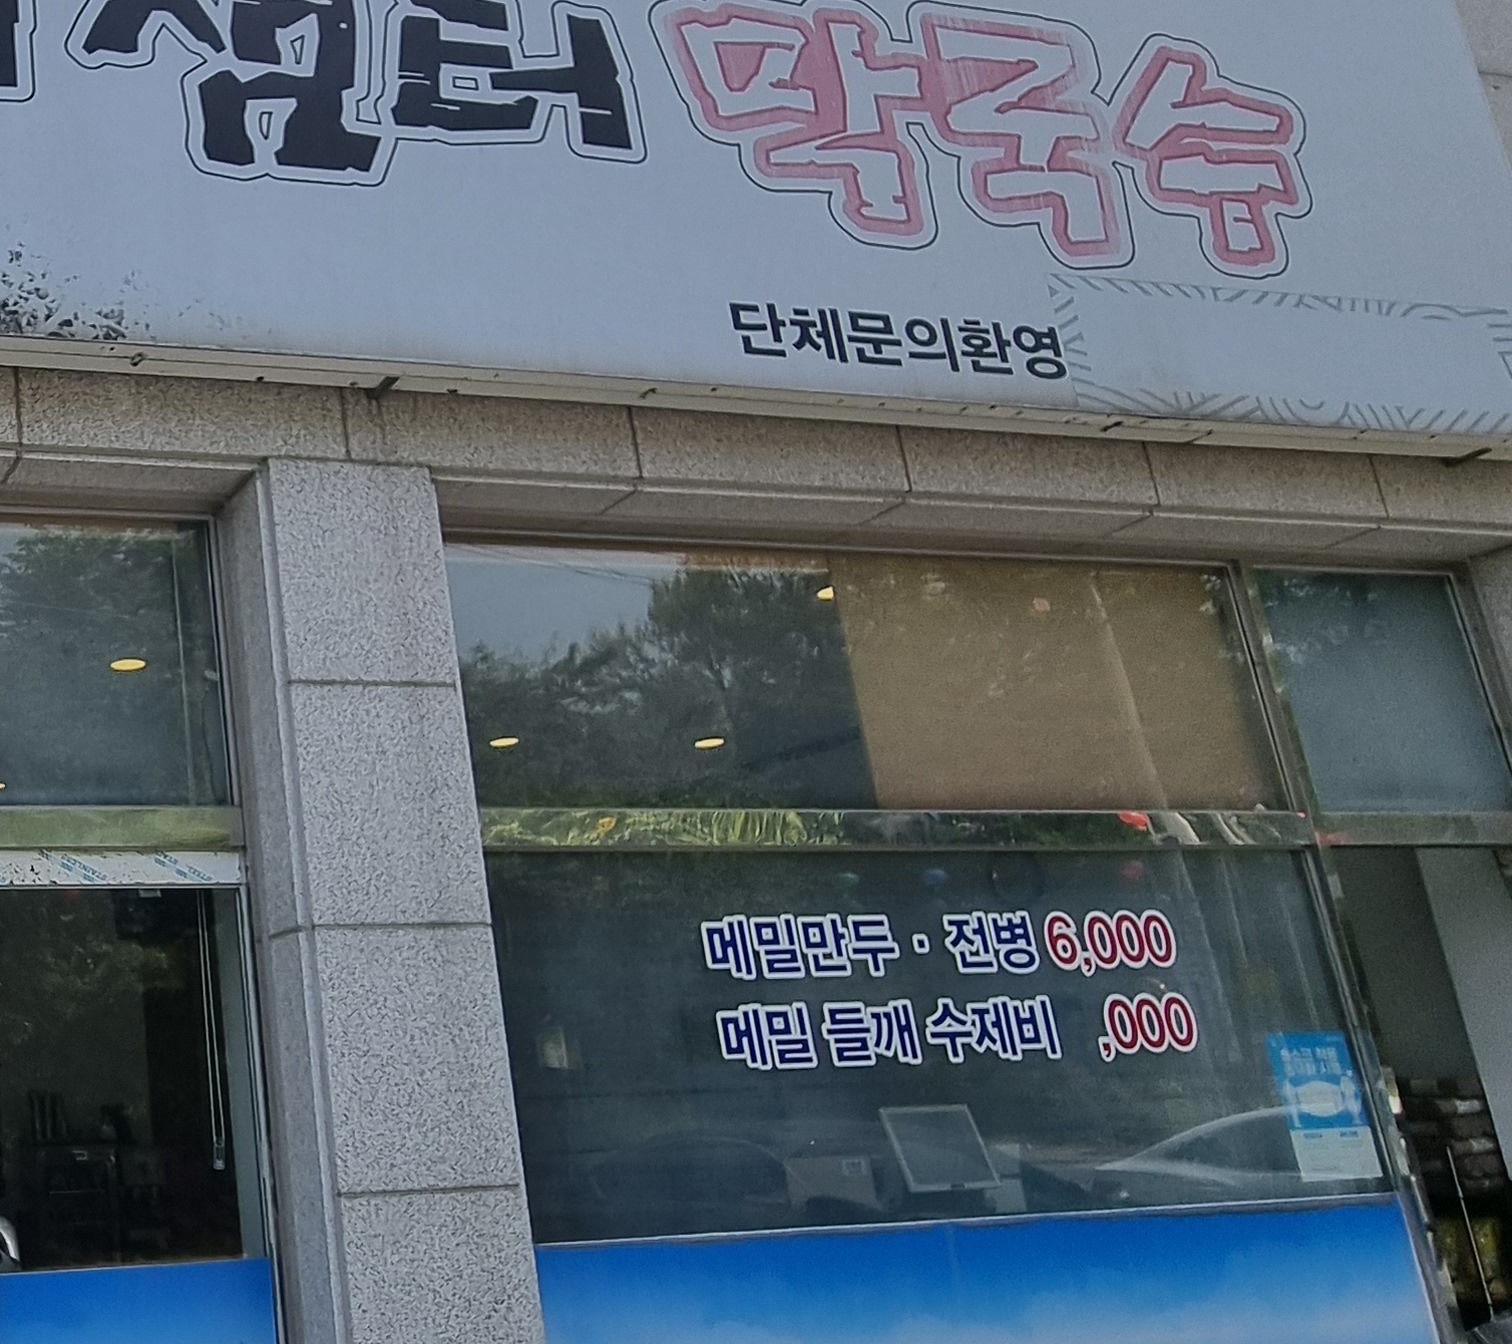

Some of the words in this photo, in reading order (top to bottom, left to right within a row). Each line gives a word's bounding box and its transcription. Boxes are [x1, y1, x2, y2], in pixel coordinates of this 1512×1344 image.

[727, 301, 1069, 381] 단체문의환영
[703, 914, 899, 979] 메밀만두
[944, 911, 1038, 974] 전병
[1045, 910, 1176, 977] 6,000
[718, 1003, 816, 1069] 메밀
[823, 997, 921, 1065] 들깨
[926, 994, 1061, 1059] 수제비
